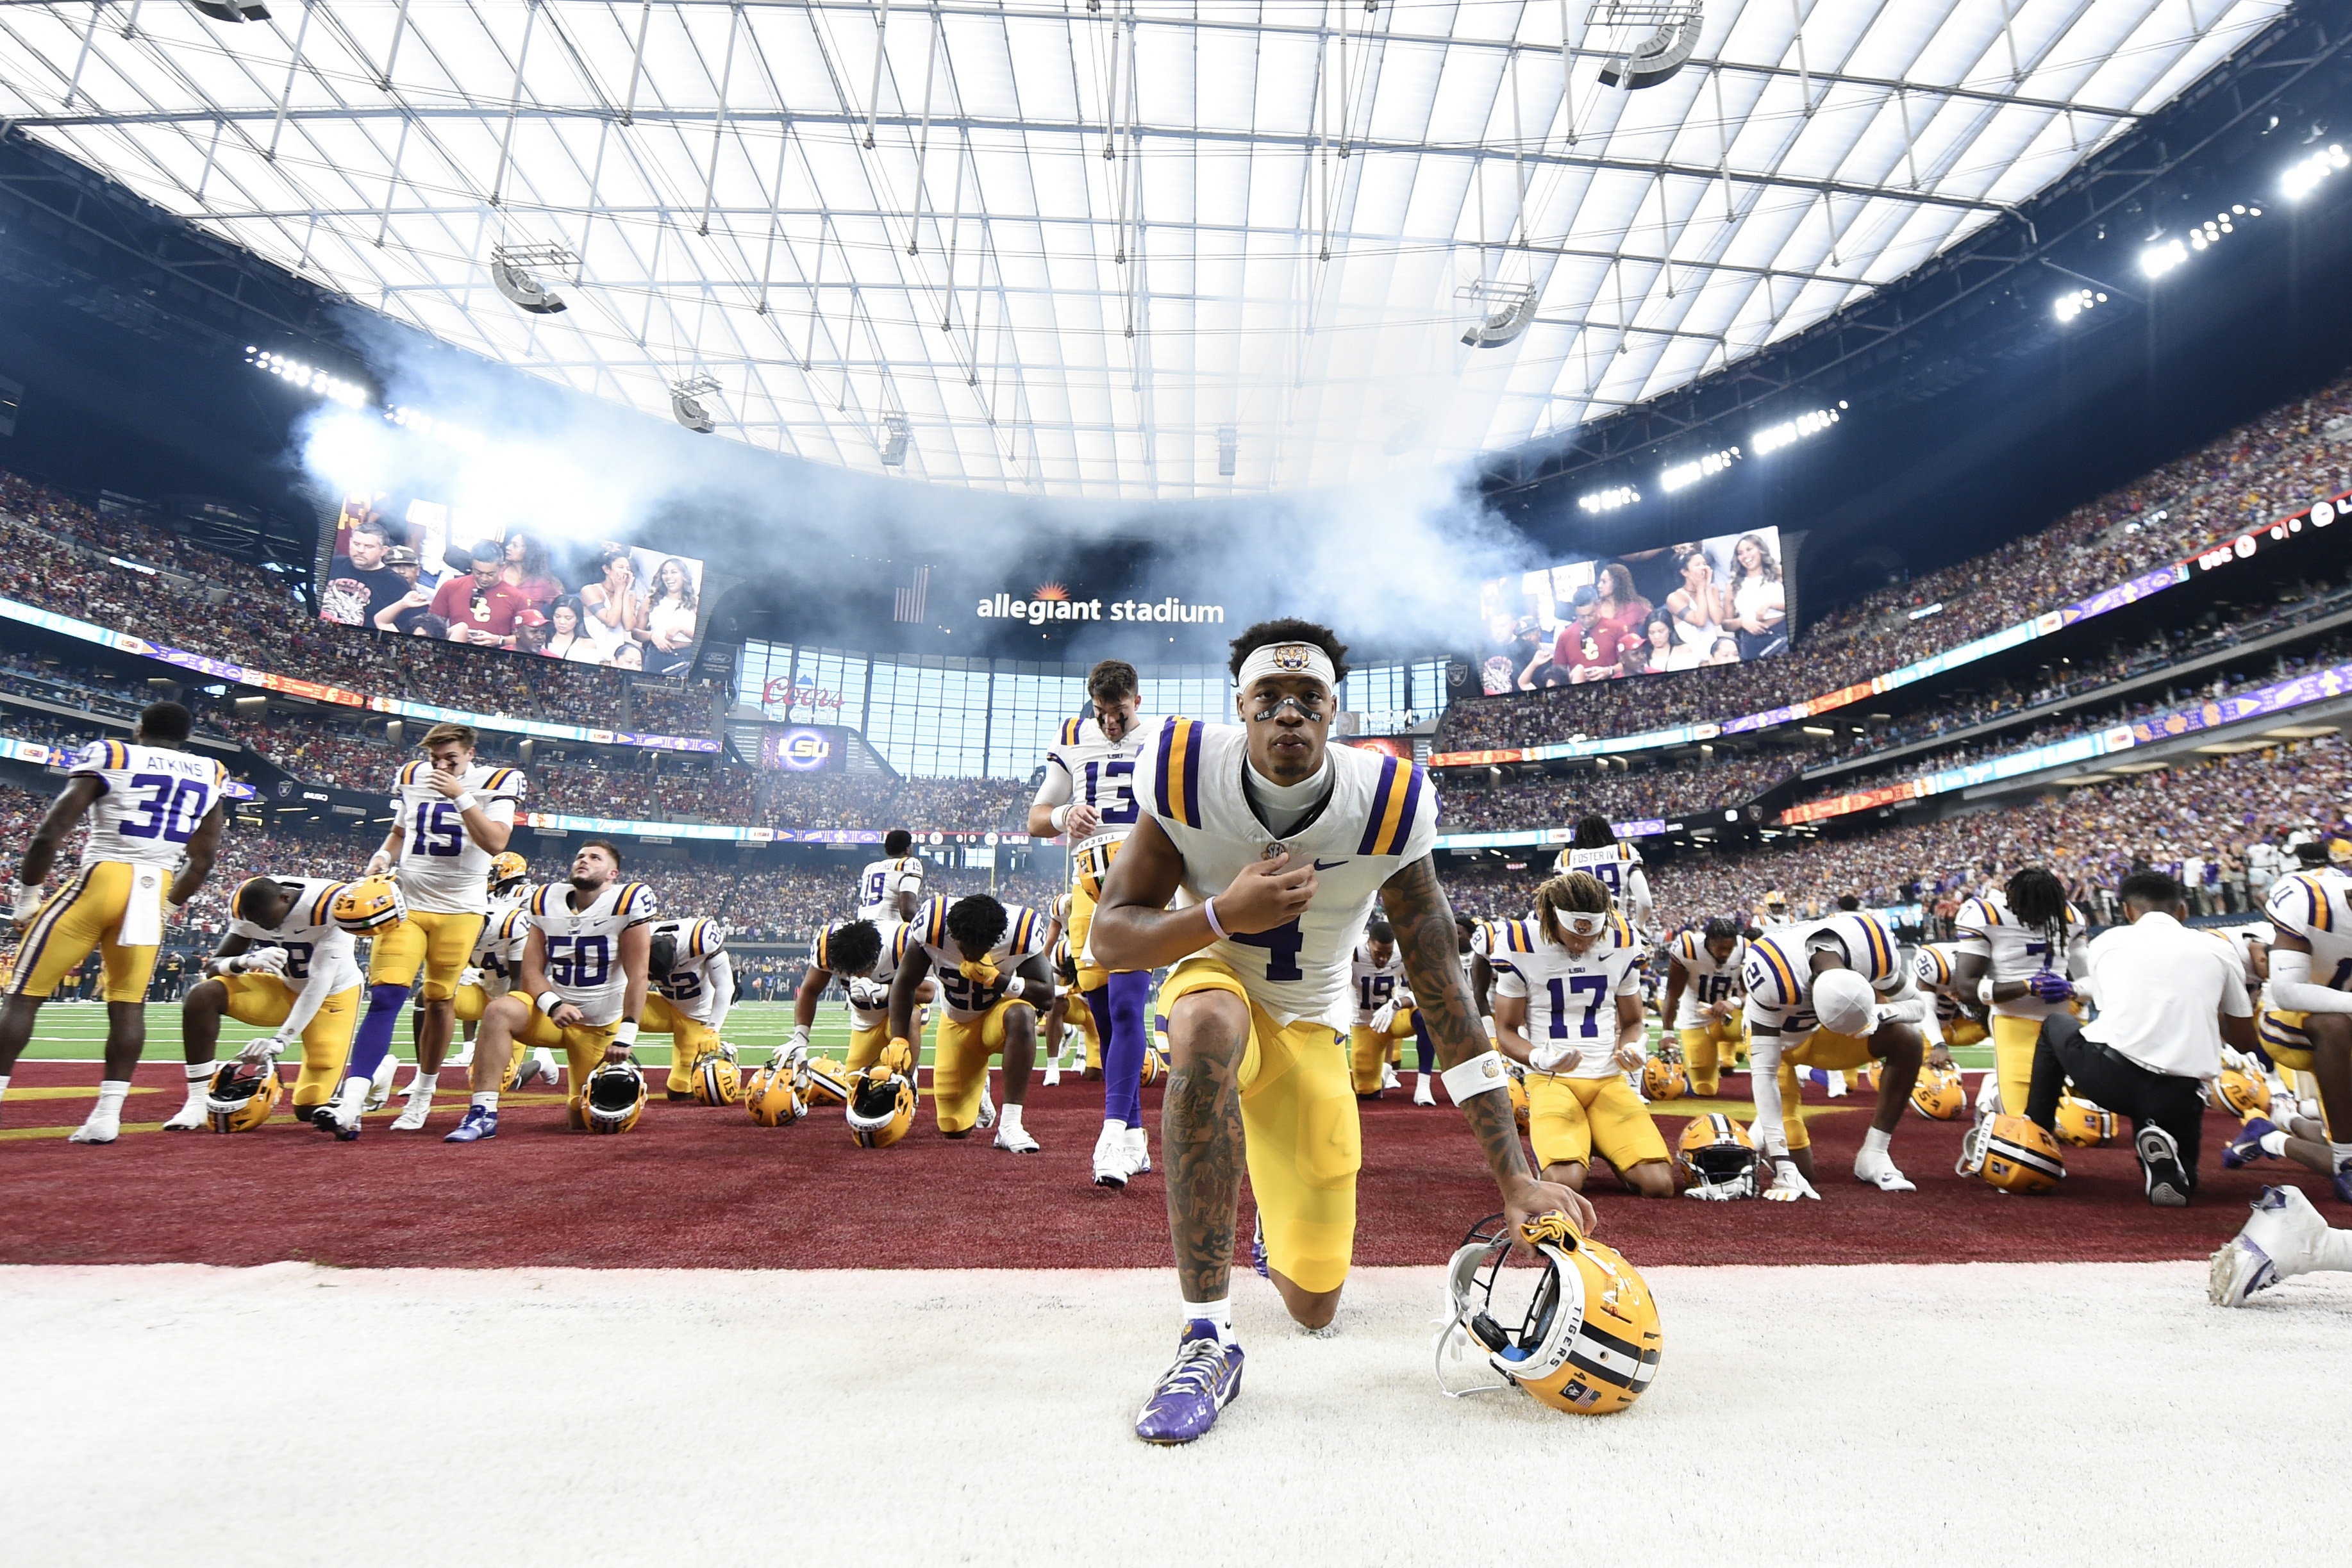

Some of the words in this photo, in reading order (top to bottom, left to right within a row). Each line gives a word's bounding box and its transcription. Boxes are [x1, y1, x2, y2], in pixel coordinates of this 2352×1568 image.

[977, 594, 1101, 625] allegiant
[1110, 597, 1224, 623] stadium
[708, 653, 728, 664] Ford
[763, 676, 845, 708] Coors
[769, 703, 834, 724] LIGHT
[1256, 710, 1270, 721] ME
[1311, 712, 1321, 722] ME
[1364, 709, 1413, 724] MGM
[778, 738, 830, 758] LSU
[147, 756, 203, 777] ATKINS
[1085, 761, 1140, 824] 13
[119, 773, 209, 844] 30
[412, 802, 463, 856] 15
[1002, 835, 1029, 844] LSU
[1080, 835, 1115, 850] TIGERS
[912, 861, 921, 872] 19
[1573, 851, 1605, 864] FOSTER
[1606, 851, 1615, 860] IV
[861, 872, 886, 907] 19
[1960, 905, 1973, 921] 7
[548, 935, 609, 987] 50
[1915, 955, 1933, 976] 26
[1698, 974, 1731, 1003] 18
[1745, 962, 1766, 994] 21
[1360, 976, 1395, 1010] 19
[1547, 974, 1608, 1039] 17
[1975, 1121, 1992, 1163] TIGERS
[1549, 1306, 1582, 1367] TIGERS
[1573, 1371, 1587, 1381] 4
